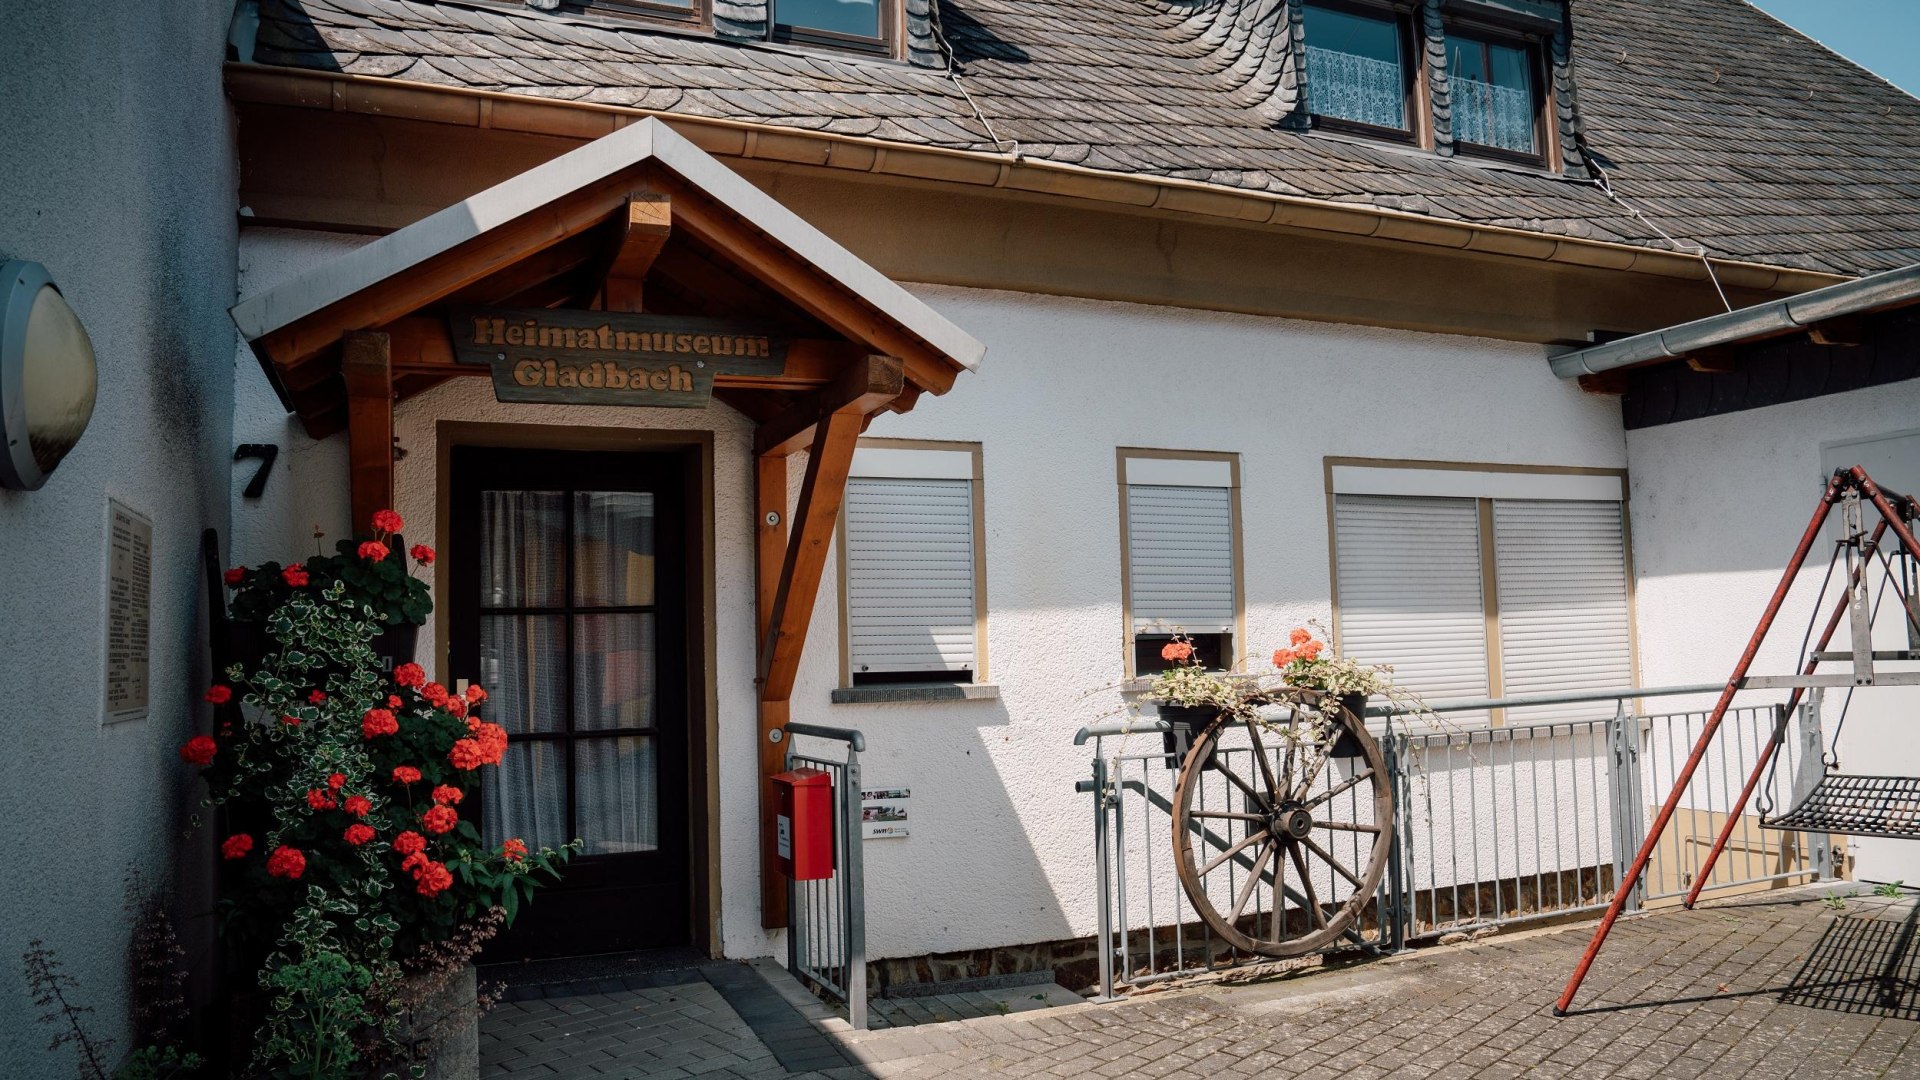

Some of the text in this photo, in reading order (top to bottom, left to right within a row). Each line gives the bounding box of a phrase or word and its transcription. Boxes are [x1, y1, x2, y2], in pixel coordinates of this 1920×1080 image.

[472, 316, 769, 358] Heimatmuseum
[512, 357, 695, 393] Gladbach
[233, 444, 279, 499] 7
